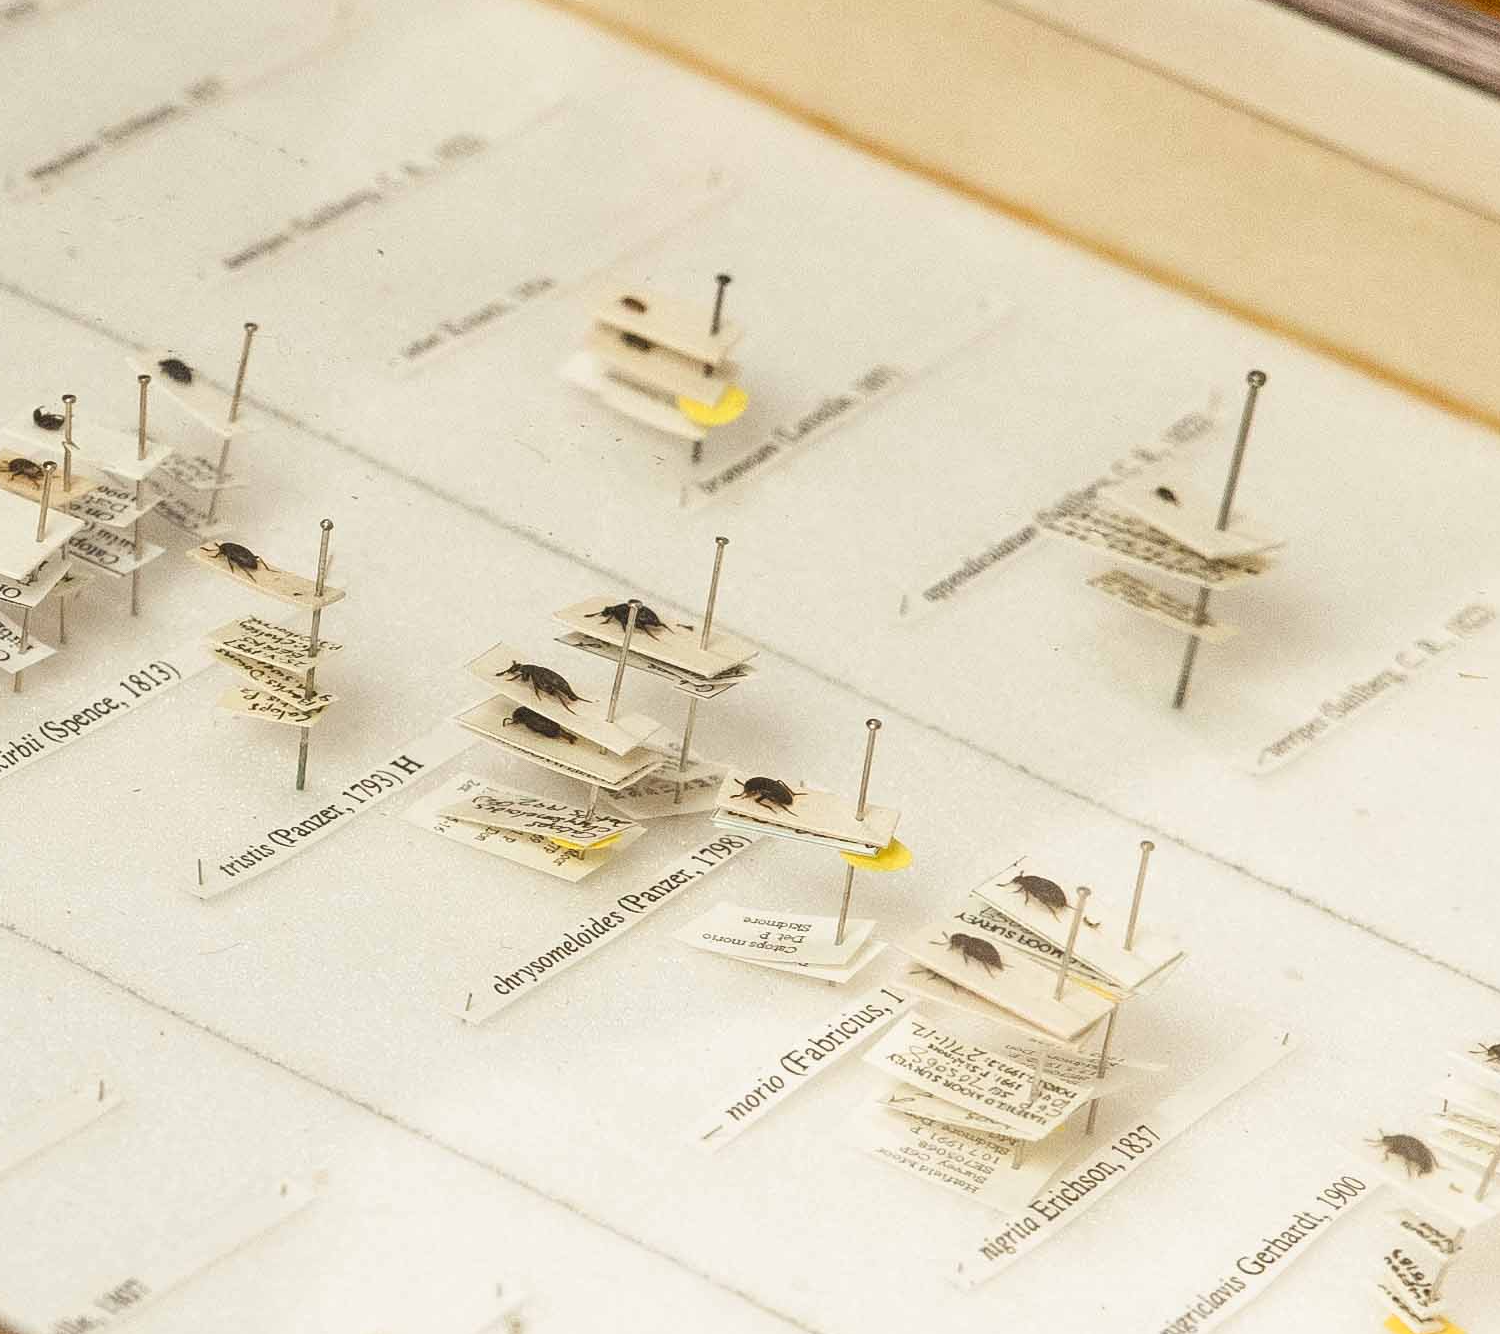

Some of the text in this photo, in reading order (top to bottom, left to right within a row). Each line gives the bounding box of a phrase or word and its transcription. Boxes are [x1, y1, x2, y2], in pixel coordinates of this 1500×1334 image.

[67, 535, 120, 567] Catop
[38, 696, 132, 745] (Spence,
[119, 659, 183, 699] 1813)
[218, 754, 426, 878] tristis (Panzer, 1793) H
[493, 833, 754, 996] chrysomeloides (Panzer, 1798)
[742, 916, 812, 932] Skidmore
[953, 911, 1018, 940] SURVEY
[724, 1074, 786, 1122] morio
[780, 1003, 894, 1077] (Fabricius,
[978, 1123, 1161, 1262] nigrita Erichson, 1837
[1235, 1210, 1334, 1277] Gerhardt,
[1315, 1175, 1368, 1211] 1900
